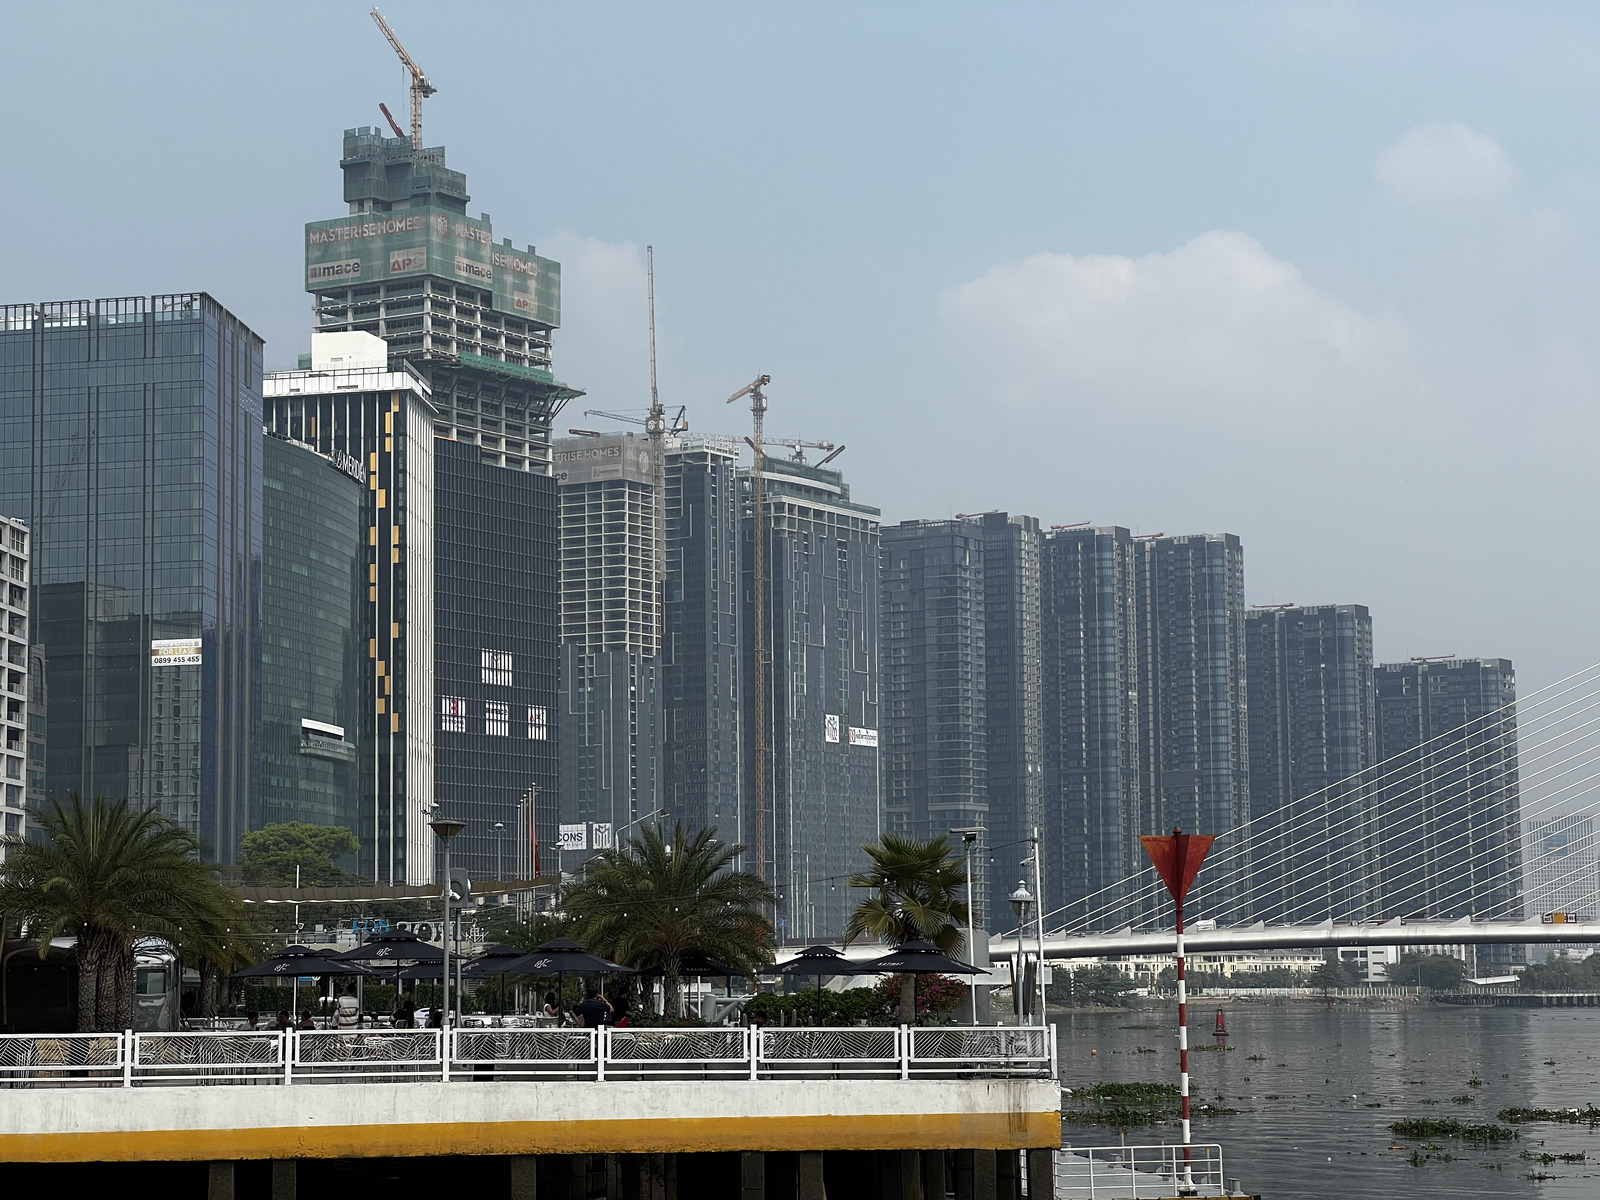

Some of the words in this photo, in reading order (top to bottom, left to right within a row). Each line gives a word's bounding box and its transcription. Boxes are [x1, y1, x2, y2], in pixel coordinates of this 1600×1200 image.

[554, 450, 583, 462] ERISE
[584, 447, 619, 459] HOMES
[159, 648, 174, 656] FOR
[175, 647, 195, 655] LEASE
